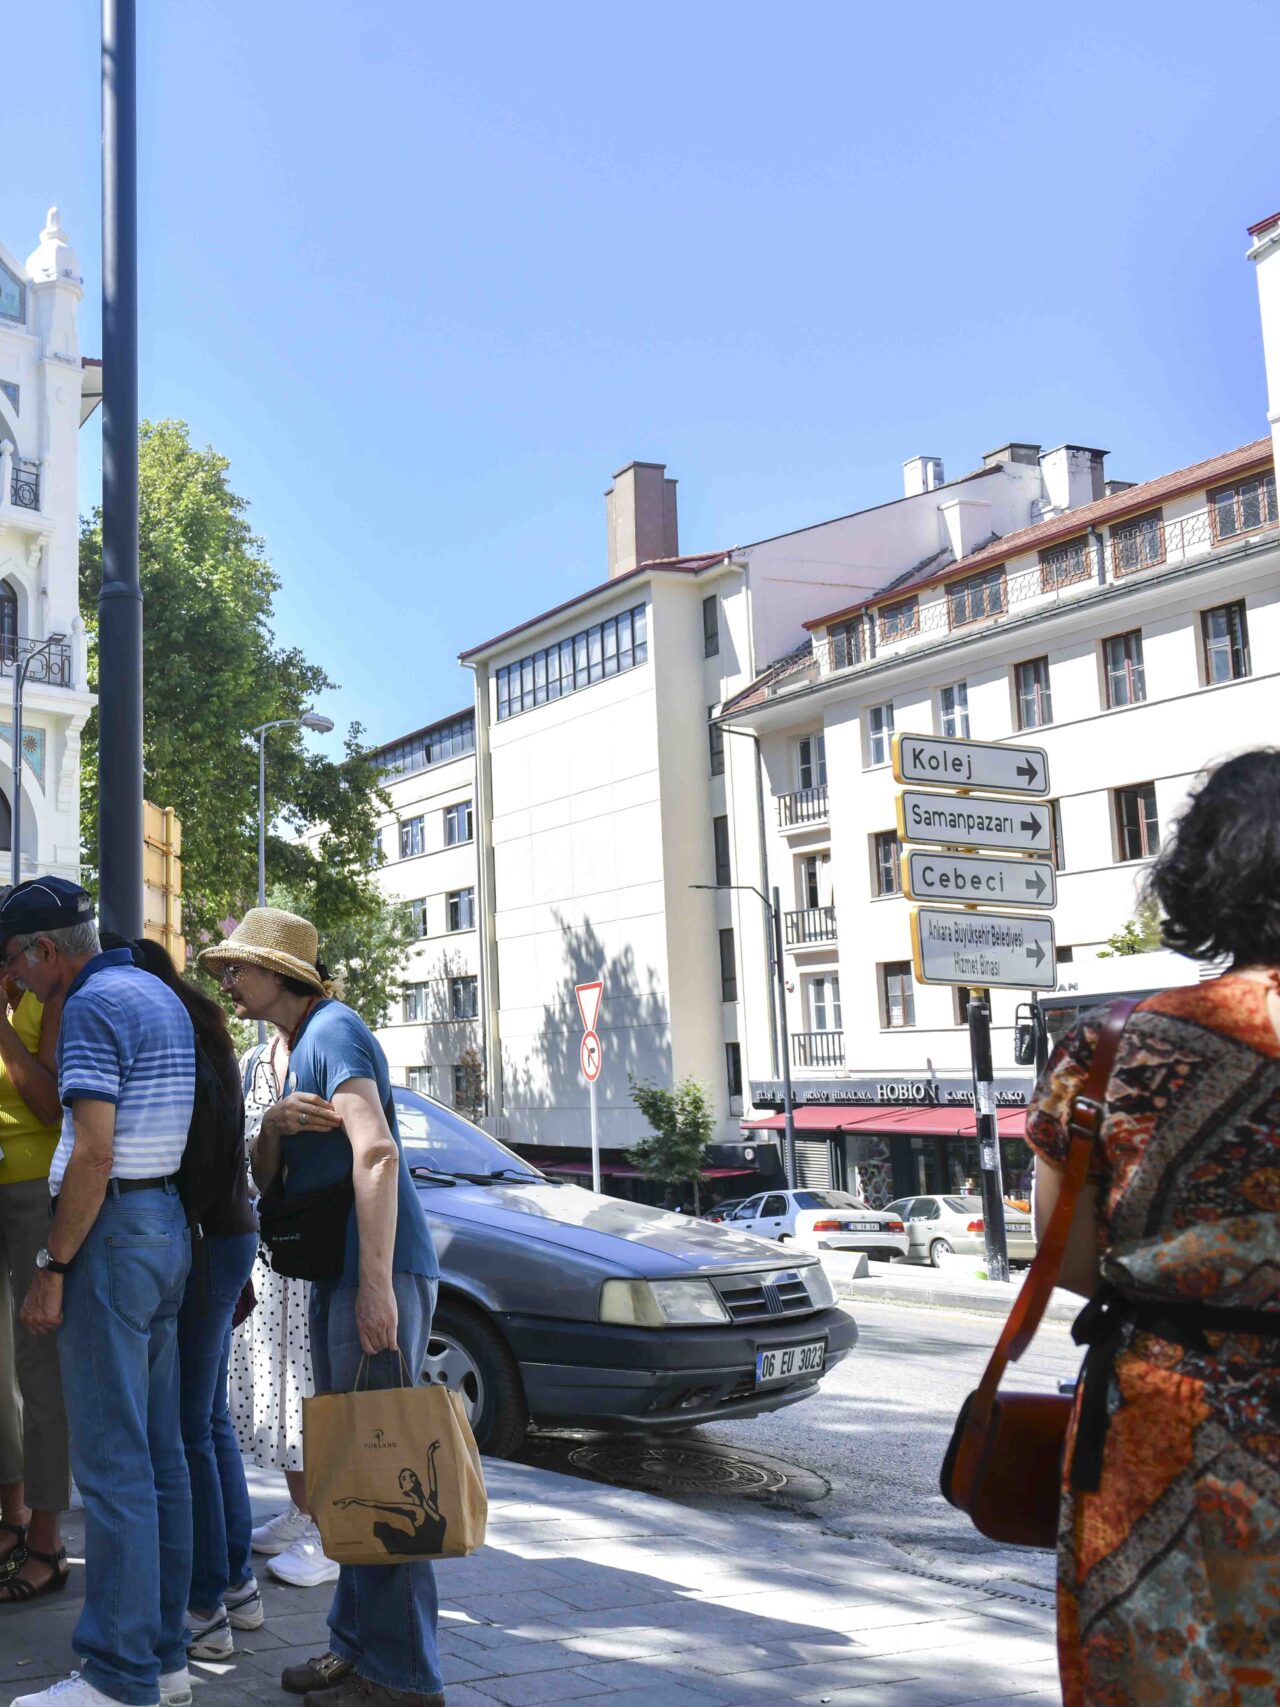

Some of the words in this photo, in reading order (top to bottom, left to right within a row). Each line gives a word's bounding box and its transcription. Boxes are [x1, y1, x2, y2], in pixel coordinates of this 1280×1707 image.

[912, 747, 973, 780] Kolej
[911, 804, 1014, 836] Samanpazarı
[921, 865, 1005, 893] Cebeci
[928, 919, 953, 943] Ankara
[954, 921, 991, 950] Büyükşehir
[991, 924, 1024, 954] Belediyesi
[953, 951, 979, 976] Hizmet
[980, 953, 1001, 977] Binası
[1056, 982, 1079, 992] AN
[762, 1353, 775, 1379] 06
[780, 1350, 795, 1376] EU
[798, 1345, 824, 1372] 3023
